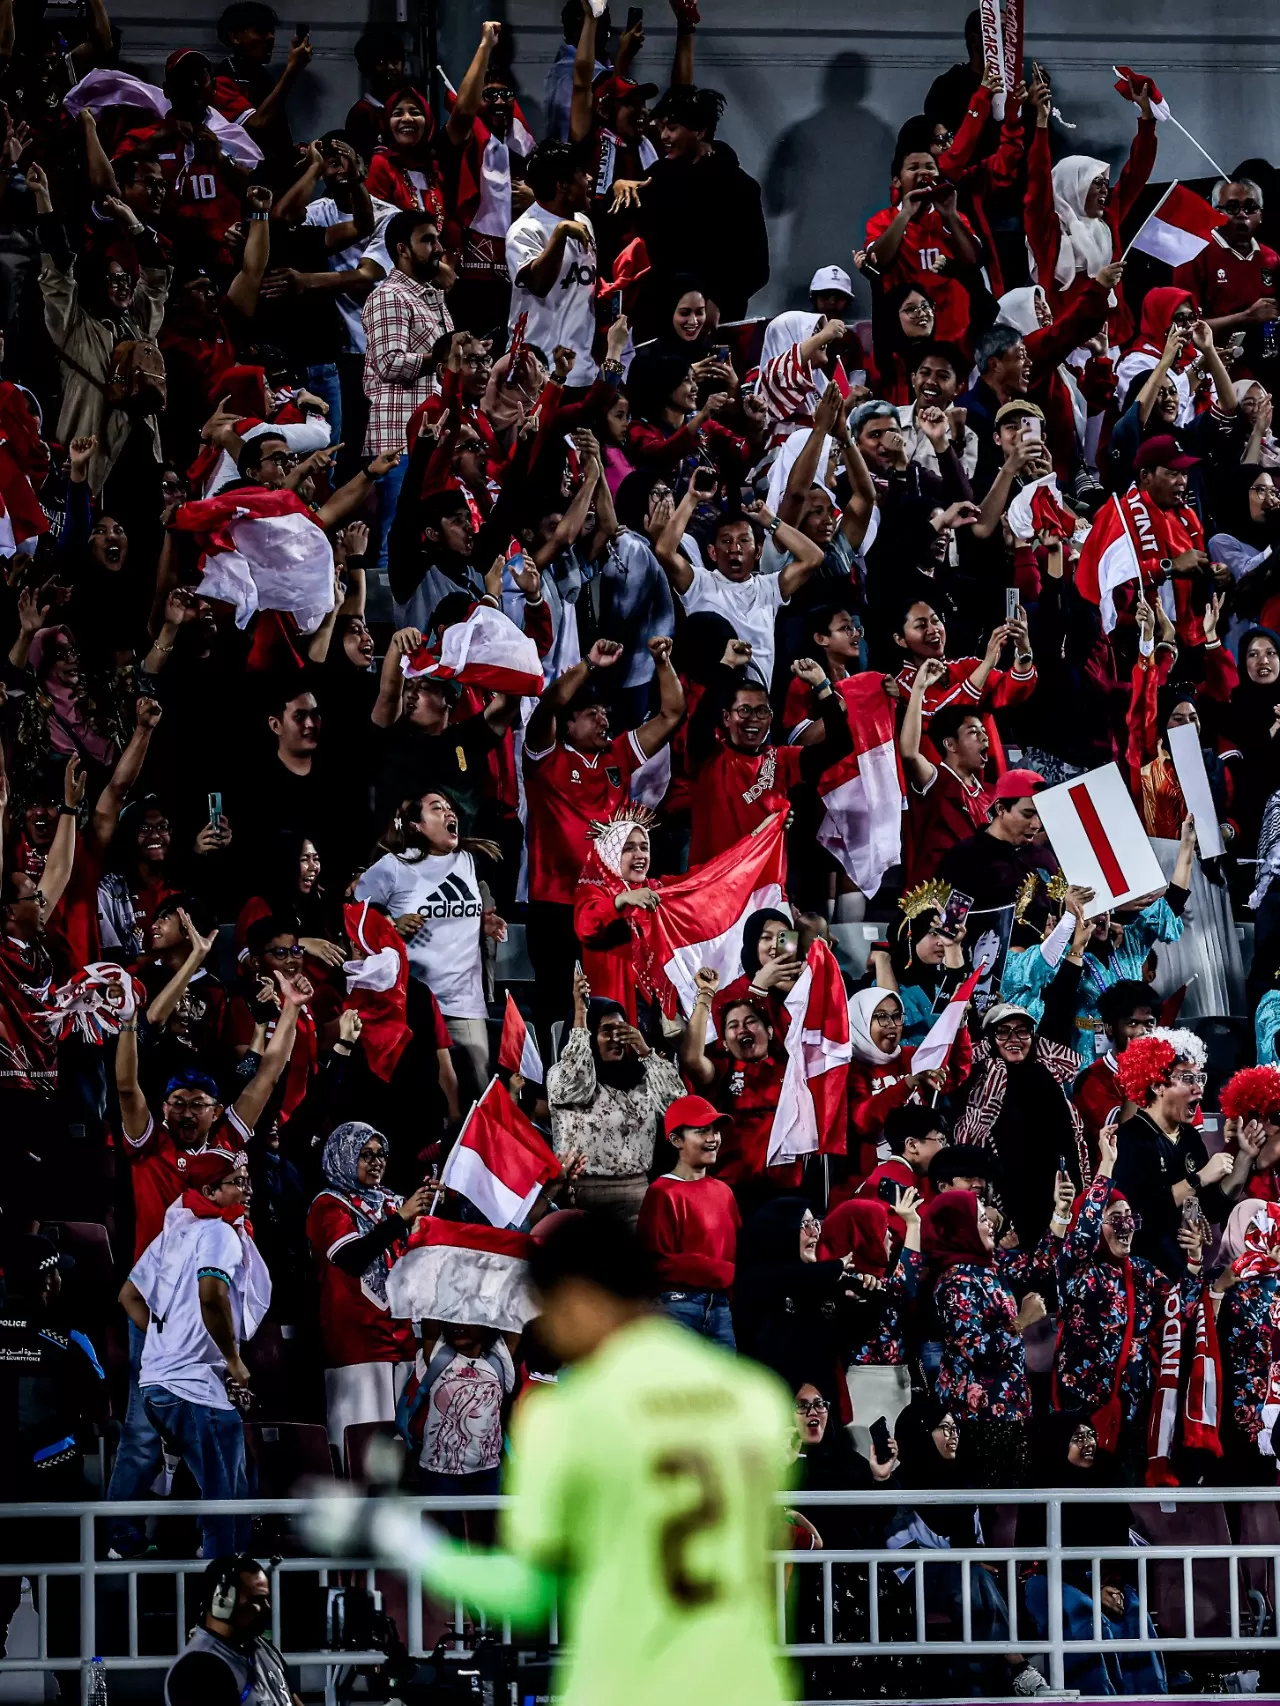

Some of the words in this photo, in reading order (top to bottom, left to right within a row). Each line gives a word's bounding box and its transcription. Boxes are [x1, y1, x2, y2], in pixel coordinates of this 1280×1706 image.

[190, 175, 217, 200] 10
[919, 248, 939, 270] 10
[1068, 783, 1131, 898] I
[417, 900, 483, 919] adidas
